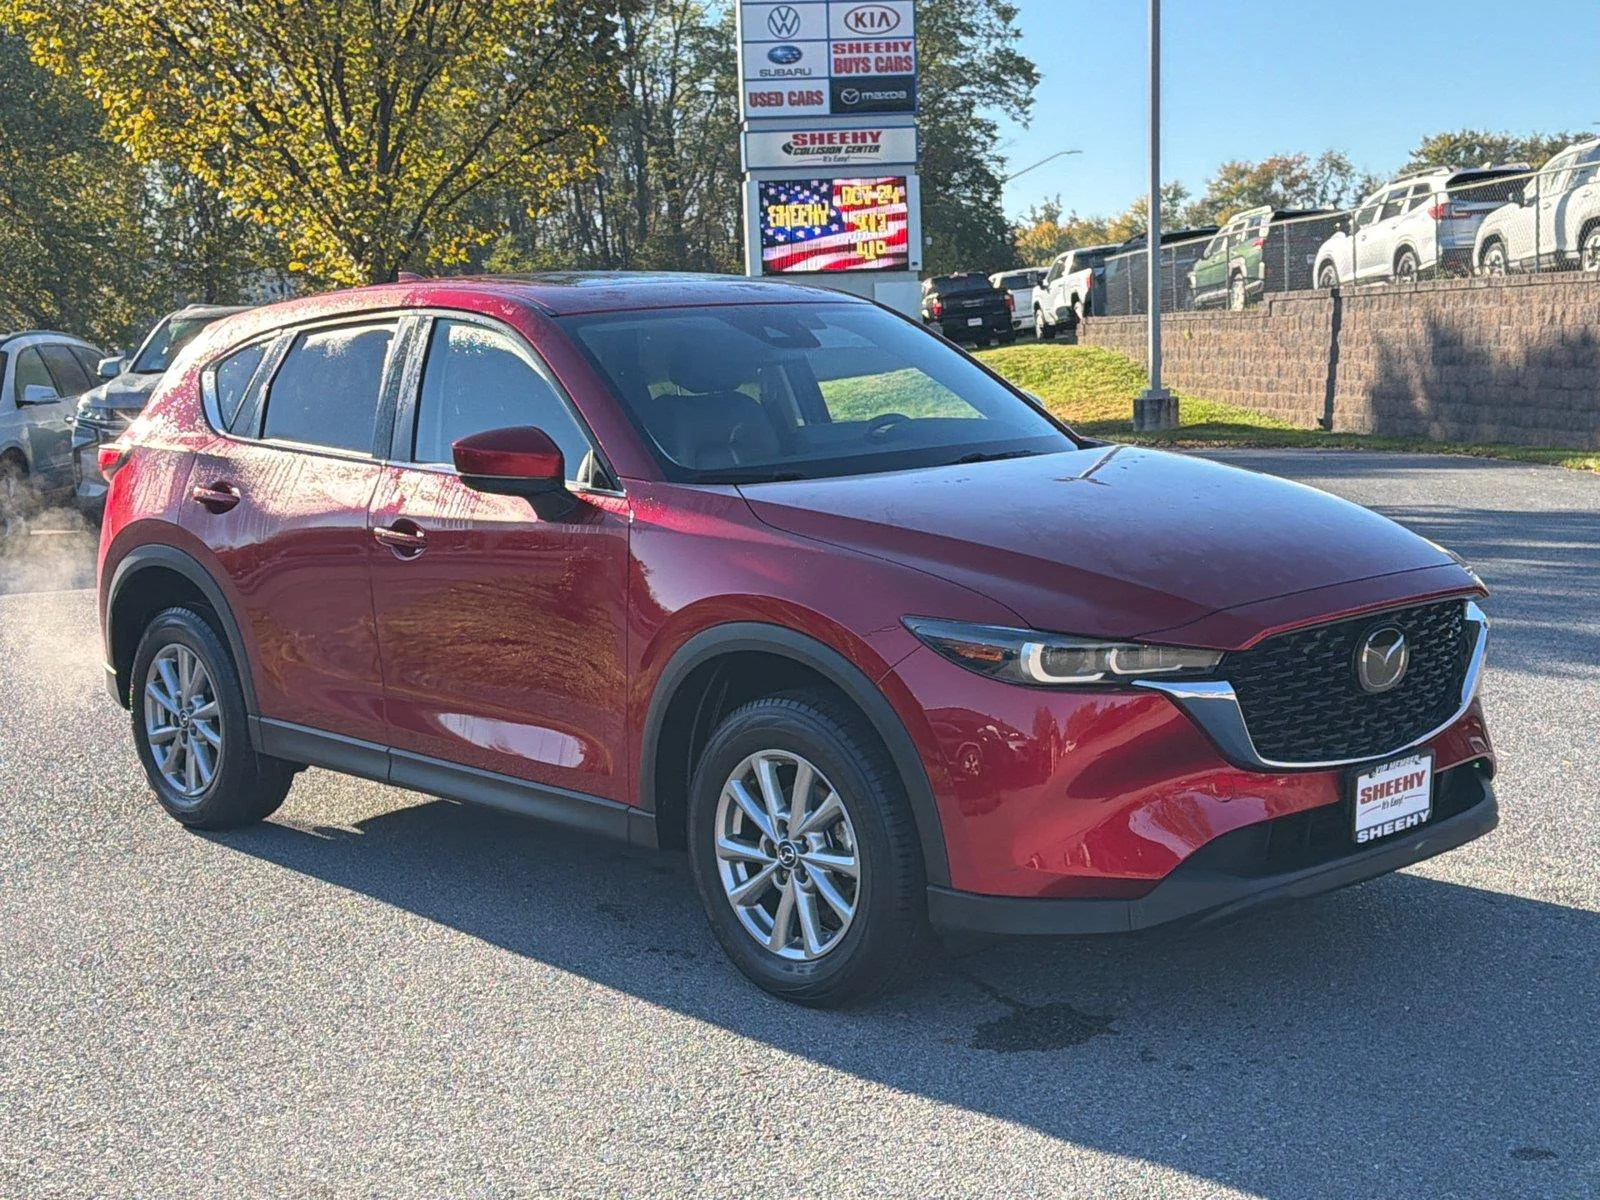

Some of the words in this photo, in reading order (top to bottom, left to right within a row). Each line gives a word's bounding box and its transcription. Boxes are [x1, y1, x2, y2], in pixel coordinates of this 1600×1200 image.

[854, 12, 891, 29] KIA
[832, 41, 912, 55] SHEEHY
[759, 67, 812, 77] SUBARU
[833, 57, 871, 74] BUYS
[875, 55, 913, 73] CARS
[748, 91, 784, 108] USED
[787, 90, 824, 106] CARS
[861, 90, 907, 100] mazda
[792, 131, 882, 146] SHEEHY
[793, 145, 842, 156] COLLISION
[844, 144, 881, 154] CENTER
[767, 202, 829, 227] SHEEHY
[1360, 770, 1426, 805] SHEEHY
[1356, 809, 1431, 843] SHEEHY
